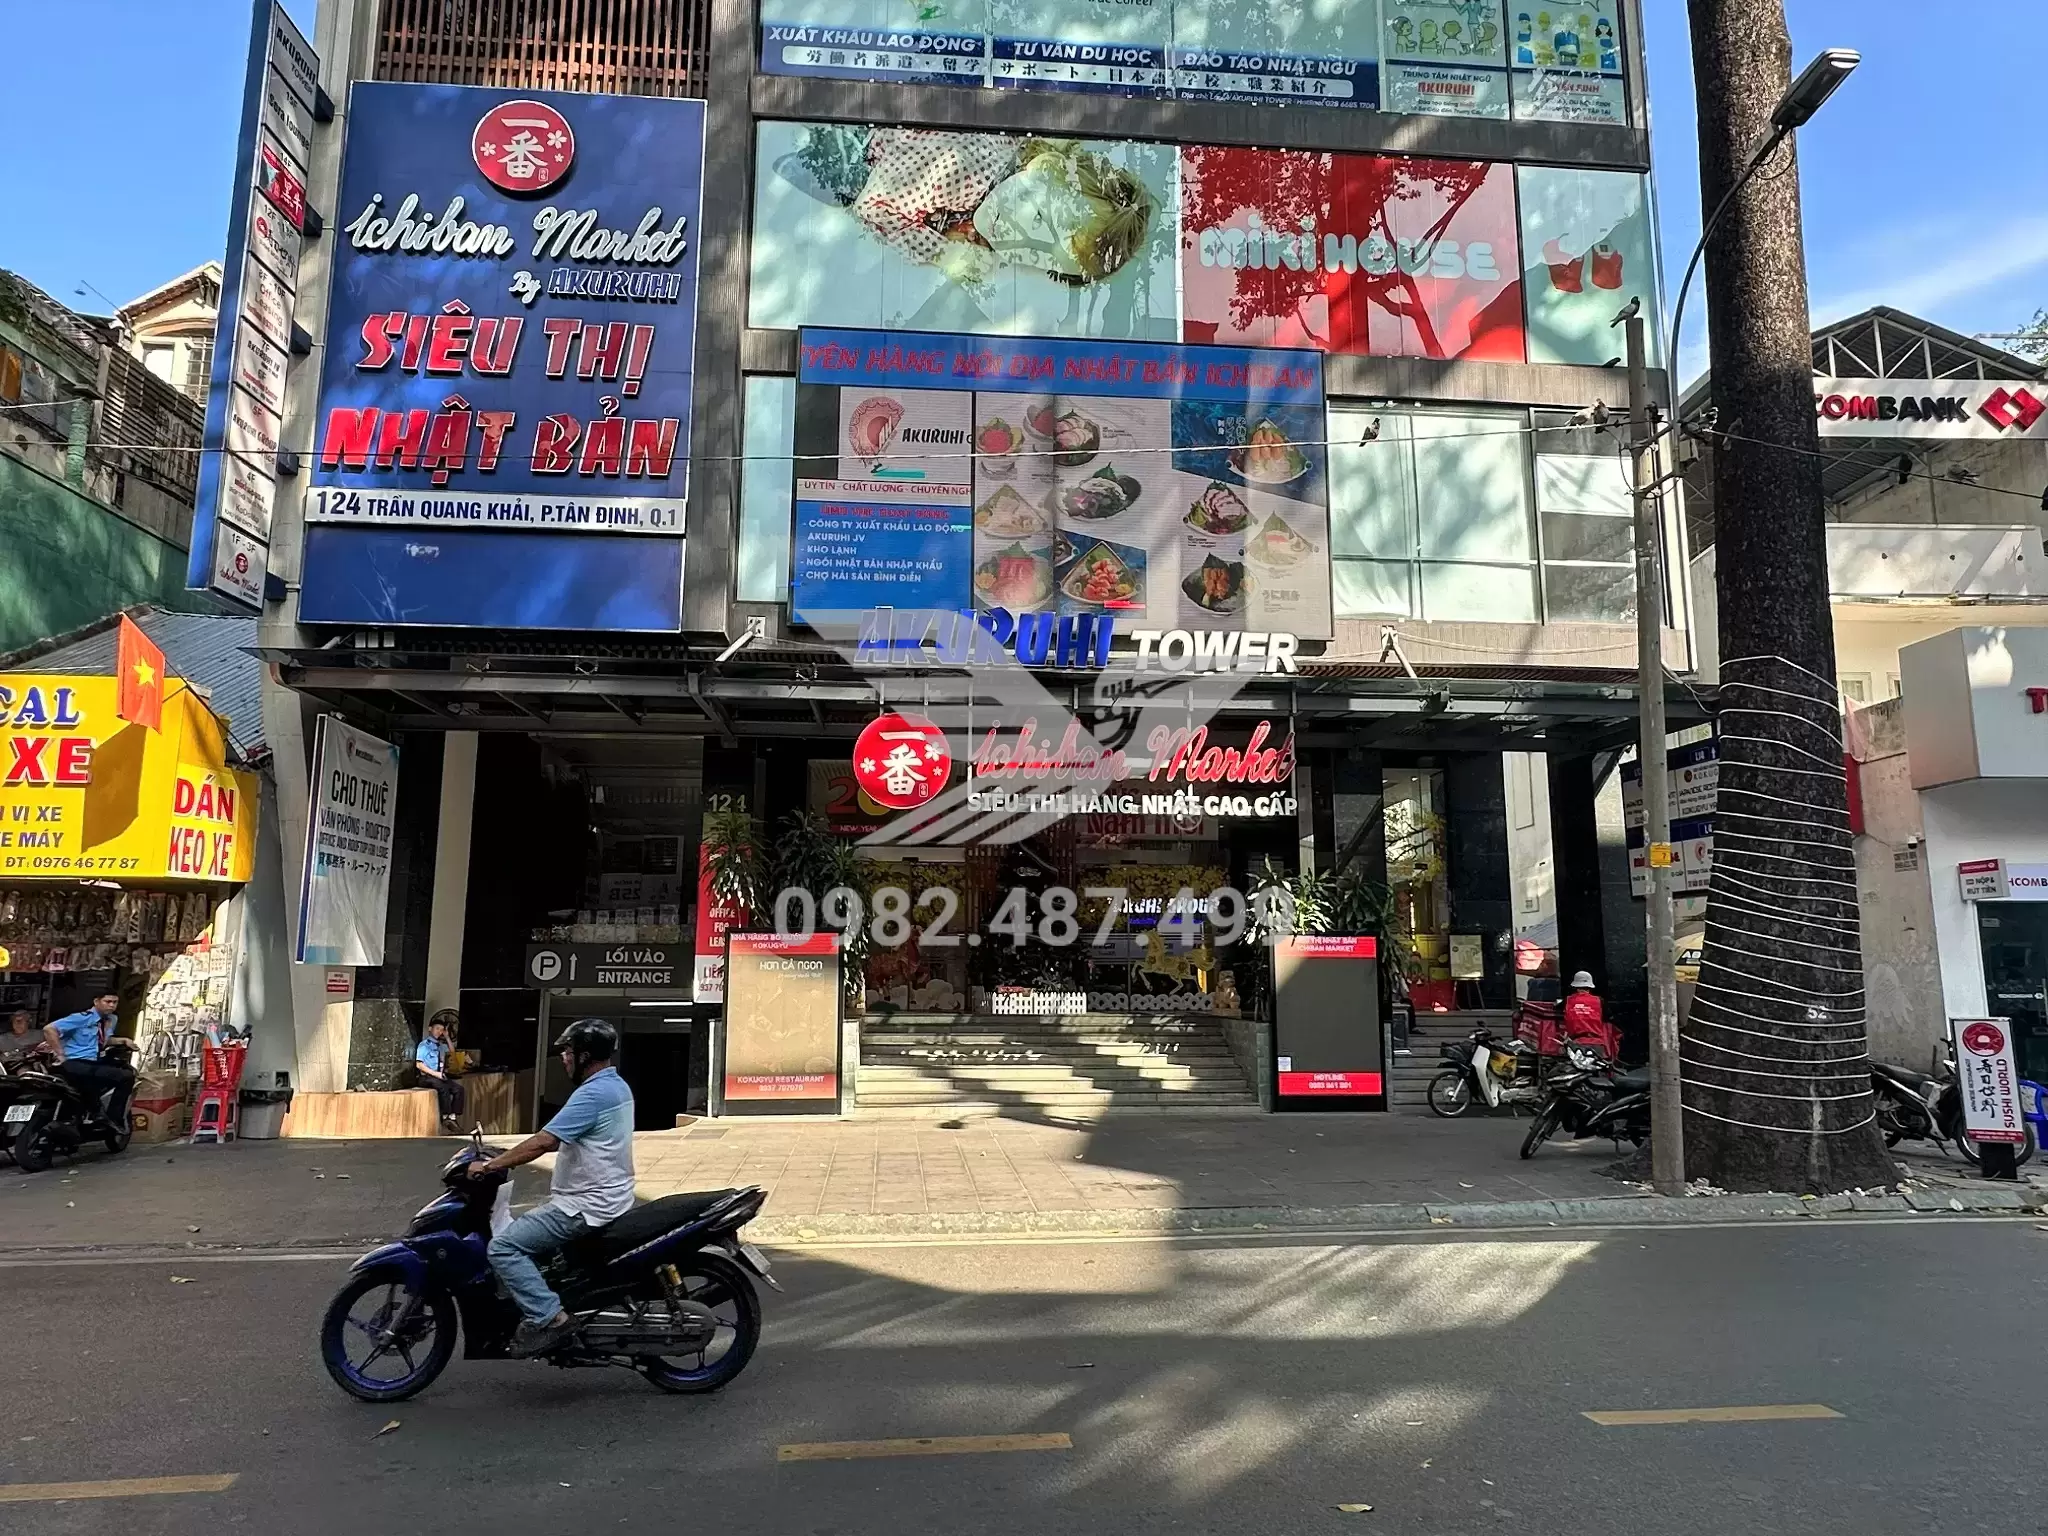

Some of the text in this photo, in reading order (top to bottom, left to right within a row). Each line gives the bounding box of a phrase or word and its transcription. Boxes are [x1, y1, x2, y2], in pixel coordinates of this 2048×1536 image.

[877, 34, 914, 48] LAO
[918, 34, 976, 54] ĐỘNG
[277, 27, 315, 85] AKURUHI
[1080, 47, 1108, 60] DU
[1111, 48, 1152, 65] HỌC
[1229, 56, 1263, 72] TẠO
[291, 63, 313, 96] TOWER
[1402, 70, 1430, 78] TRUNG
[1432, 71, 1448, 80] TÂM
[1417, 82, 1476, 95] AKURUHI
[1265, 96, 1292, 104] TOWER
[286, 115, 310, 150] lounge
[497, 118, 549, 178] 一番
[280, 152, 292, 167] 14F
[263, 204, 277, 221] 12F
[532, 207, 687, 263] Market
[1324, 233, 1500, 281] HOUSE
[509, 268, 681, 304] By AKURUHI
[262, 340, 270, 352] 7F
[356, 299, 654, 395] SIÊU THỊ
[865, 344, 945, 373] HÀNG
[1063, 352, 1139, 386] NHẬT
[1205, 362, 1314, 389] ICHIBAN
[320, 394, 678, 484] NHẬT BẢN
[902, 428, 964, 444] AKURUHI
[247, 472, 256, 482] 4F
[804, 481, 818, 489] UY
[819, 481, 836, 490] TÍN
[842, 481, 868, 491] CHẤT
[316, 491, 361, 518] 124
[367, 492, 415, 518] TRẦN
[420, 500, 482, 523] QUANG
[540, 499, 591, 524] P.TÂN
[595, 504, 643, 529] ĐỊNH,
[649, 510, 677, 528] Q.1
[808, 518, 839, 528] CÔNG
[841, 520, 853, 529] TY
[855, 519, 880, 531] XUẤT
[913, 523, 932, 532] LAO
[232, 533, 256, 553] 1F 3F
[808, 532, 865, 542] AKURUHI JV
[807, 545, 857, 555] KHO LẠNH
[806, 570, 828, 581] CHỢ
[874, 571, 897, 582] BÌNH
[853, 605, 1299, 675] AKURUHI TOWER
[1147, 720, 1297, 783] Market
[3, 736, 94, 787] XE
[877, 730, 928, 796] 一番
[174, 774, 235, 825] DÁN
[331, 769, 389, 817] CHO THUÊ
[708, 794, 747, 812] 124
[967, 787, 1298, 821] SIÊU THỊ HÀNG NHẬT CAO CẤP
[12, 806, 62, 825] VỊ XE
[321, 807, 336, 829] VĂN
[365, 821, 391, 843] ROOFTOP
[18, 829, 64, 848] MÁY
[319, 831, 336, 848] OFFICE
[337, 836, 347, 849] AND
[168, 826, 233, 877] KEO XE
[33, 857, 71, 868] 0976
[74, 857, 94, 868] 46
[98, 858, 117, 869] 77
[119, 858, 140, 869] 87
[605, 946, 665, 964] LỐI VÀO
[1326, 945, 1354, 953] MARKET
[597, 972, 671, 984] ENTRANCE
[1808, 1007, 1828, 1019] 52
[775, 1075, 824, 1083] RESTAURANT
[1996, 1058, 2016, 1128] SUSHI WORLD
